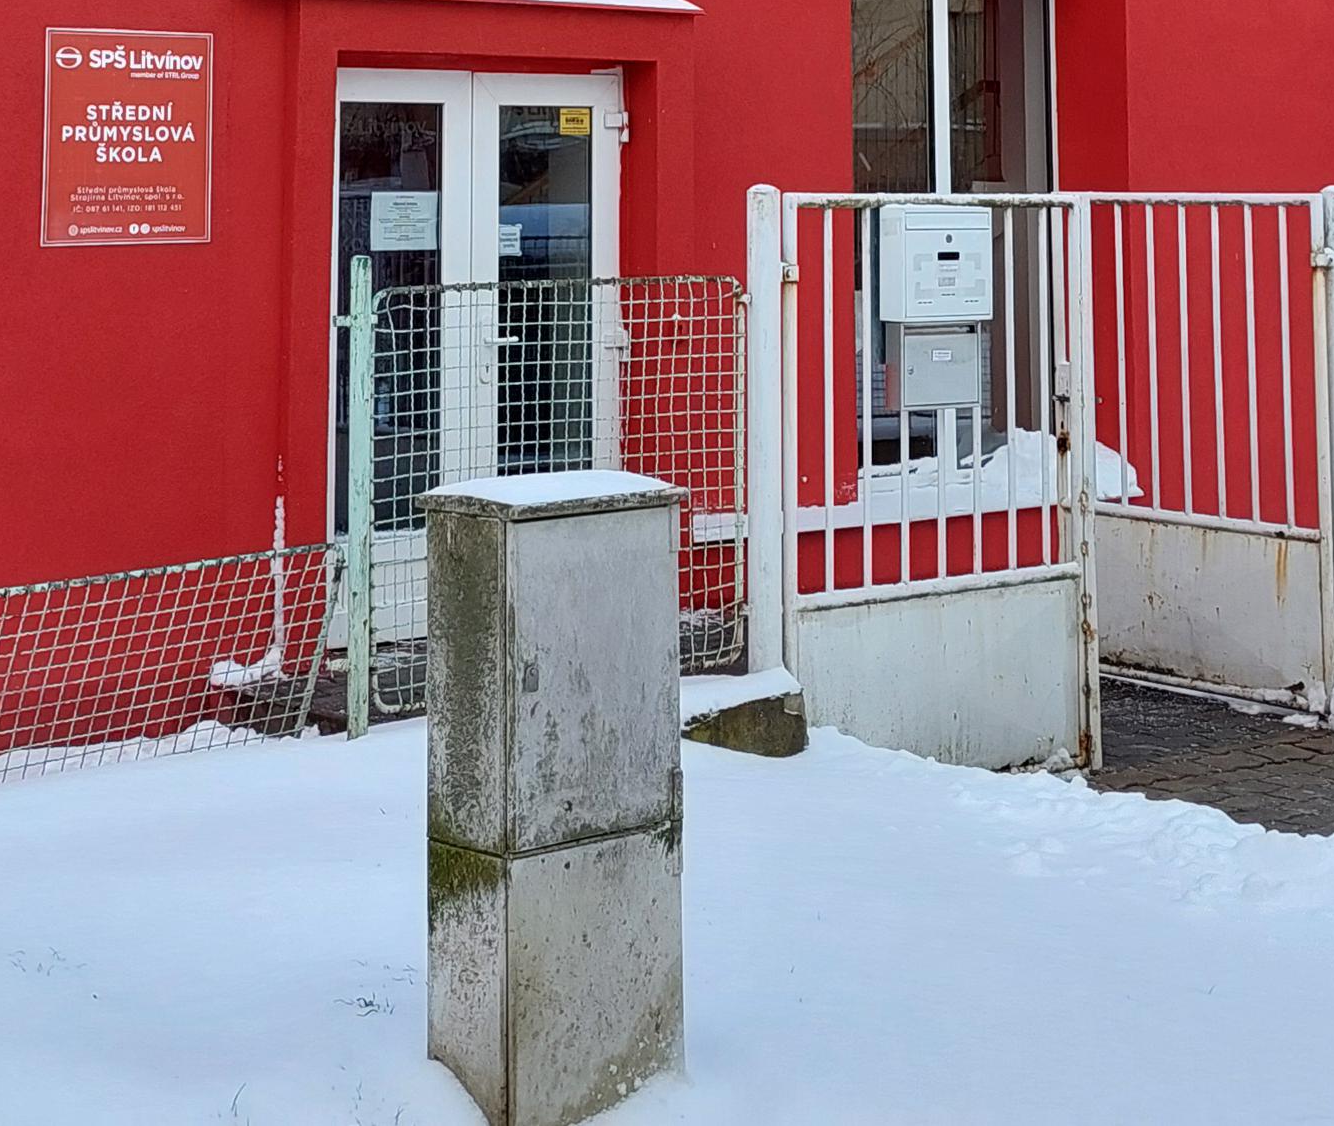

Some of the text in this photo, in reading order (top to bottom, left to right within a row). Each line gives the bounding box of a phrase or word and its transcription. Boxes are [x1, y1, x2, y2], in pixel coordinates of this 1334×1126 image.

[89, 45, 203, 71] SPŠ Litvínov
[86, 101, 173, 121] STŘEDNÍ
[61, 121, 195, 142] PRŮMYSLOVÁ
[96, 143, 162, 162] ŠKOLA
[77, 186, 106, 194] Střední
[108, 186, 154, 195] průmyslová
